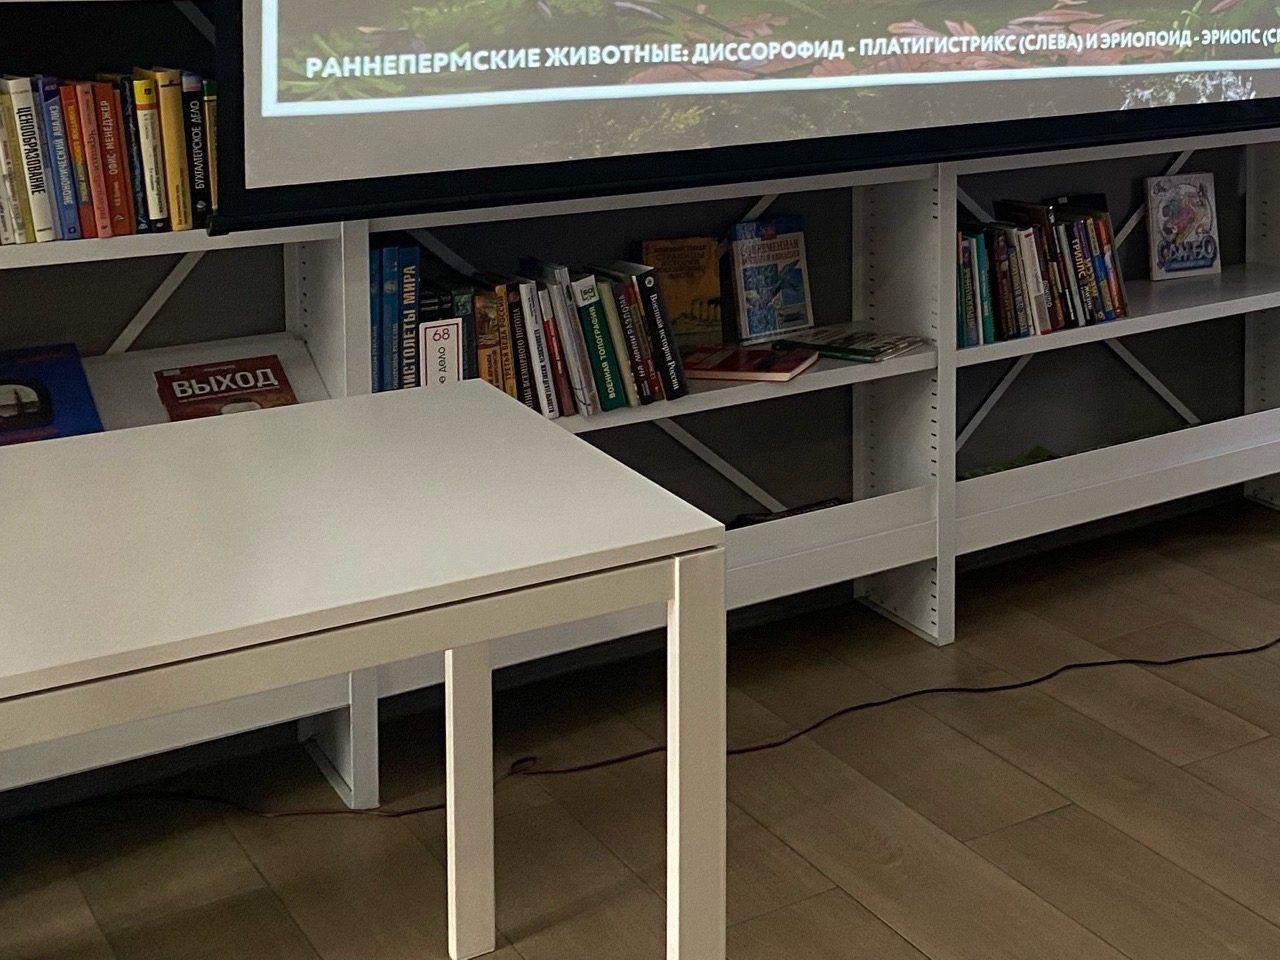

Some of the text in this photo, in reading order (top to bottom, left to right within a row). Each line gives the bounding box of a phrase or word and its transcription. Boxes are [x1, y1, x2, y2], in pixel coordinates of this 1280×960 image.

[306, 47, 540, 79] РАННЕПЕРМСКИЕ
[545, 43, 689, 68] ЖИВОТНЫЕ:
[692, 39, 845, 64] ДИССОРОФИД
[859, 34, 1018, 57] ПЛАТИГИСТРИКС
[1019, 32, 1085, 55] (СЛЕВА)
[1086, 35, 1098, 50] И
[1100, 29, 1193, 51] ЭРИОПОИД
[1201, 28, 1261, 46] ЭРИОПС
[16, 107, 46, 195] ЦЕНООБРАЗОВАНИЕ
[49, 105, 73, 205] ЭКОНОМИЧЕСКИЙ АНАЛИЗ
[189, 100, 205, 189] БУХГАЛТЕРСКОЕ ДЕЛО
[1071, 239, 1086, 279] ГРИЛЛС
[403, 265, 416, 304] МИРА
[432, 328, 450, 341] 68
[618, 295, 633, 334] РАЗЛОМА
[589, 306, 616, 399] ВОЕННАЯ ТОПОГРАФИЯ
[650, 293, 680, 390] Военная история России
[172, 368, 280, 398] ВЫХОД
[638, 366, 646, 377] НА
